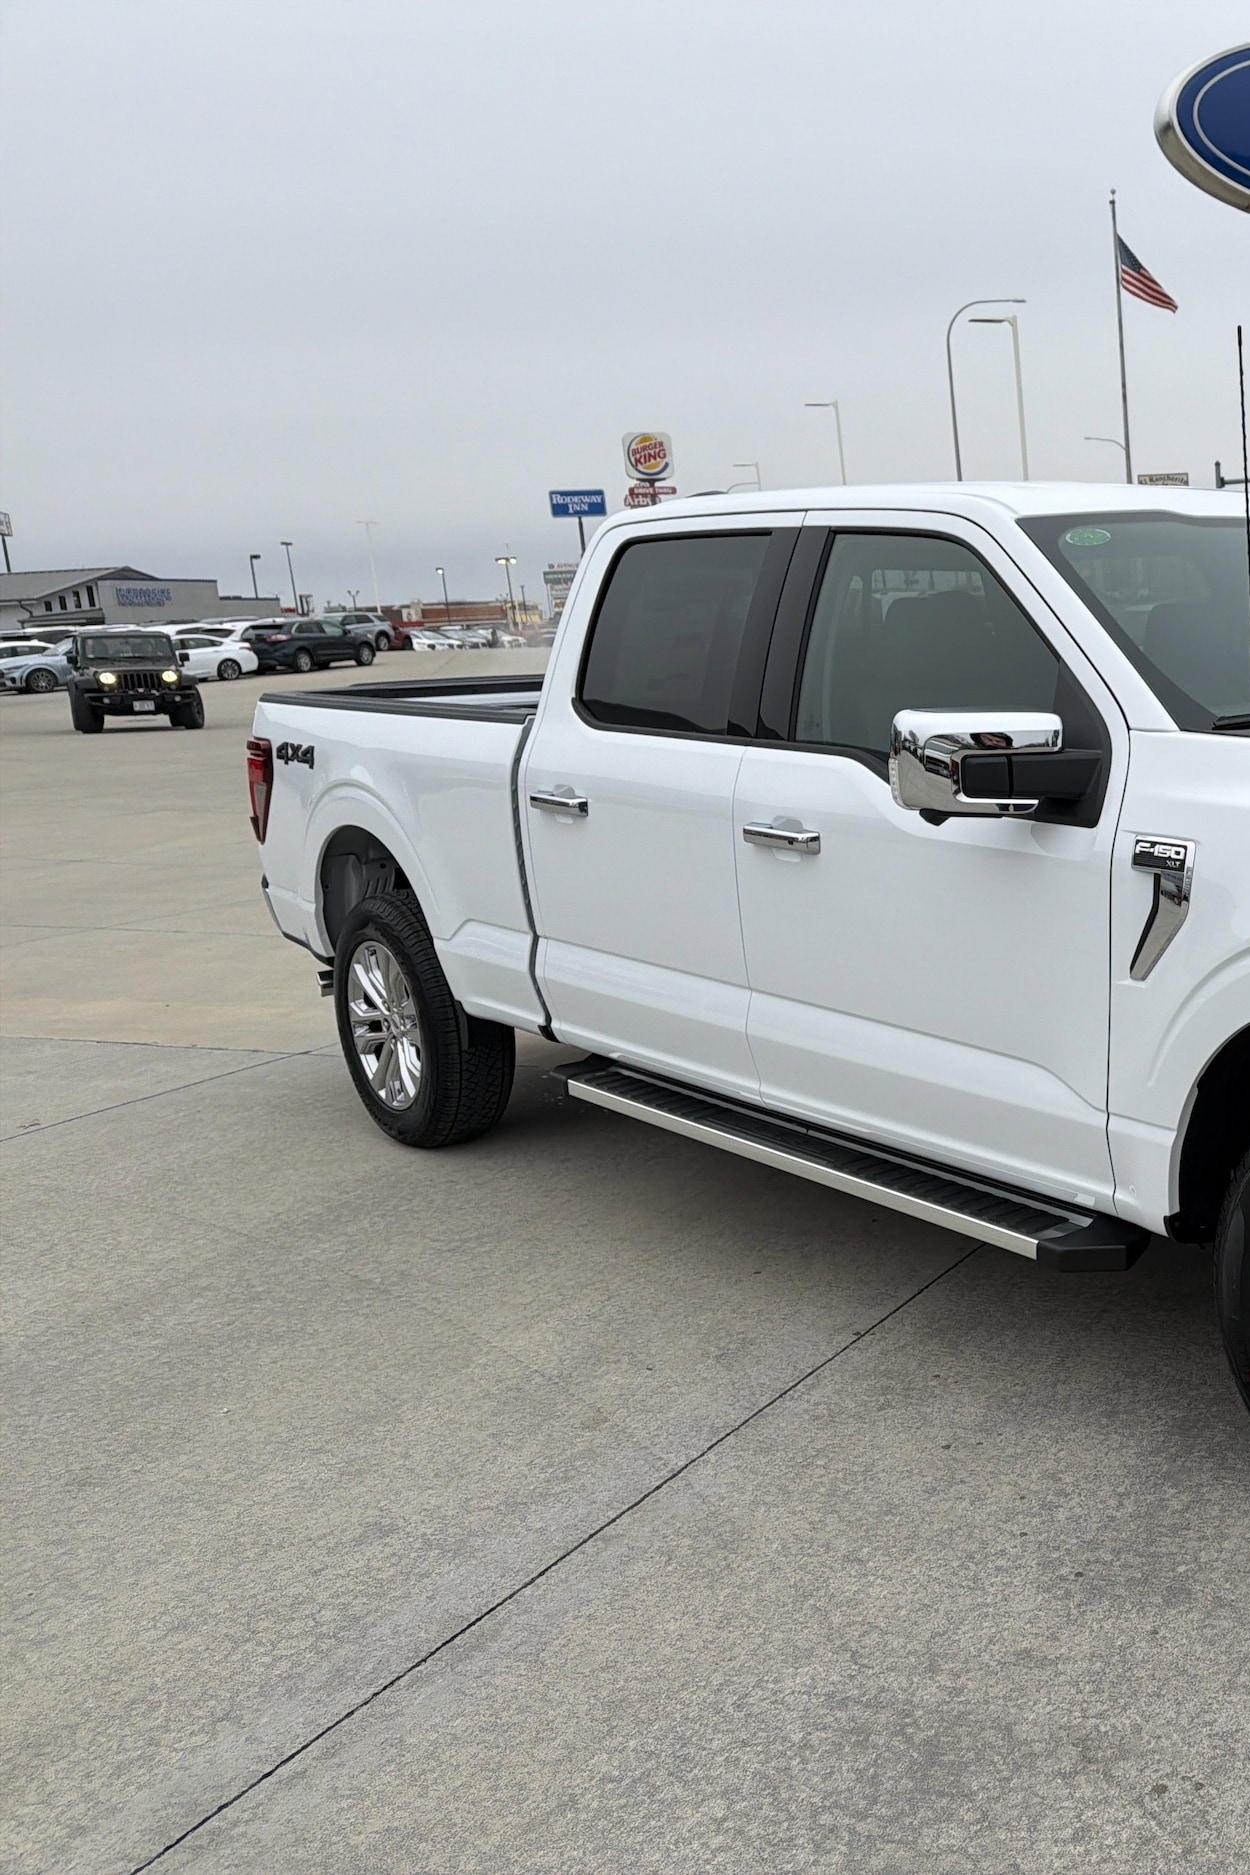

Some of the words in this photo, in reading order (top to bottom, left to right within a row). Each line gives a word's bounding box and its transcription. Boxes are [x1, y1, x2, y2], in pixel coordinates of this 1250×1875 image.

[632, 440, 664, 457] BURGER
[633, 448, 667, 467] KING
[568, 503, 589, 514] INN
[1135, 841, 1186, 860] F-150
[1165, 860, 1180, 868] XLT
